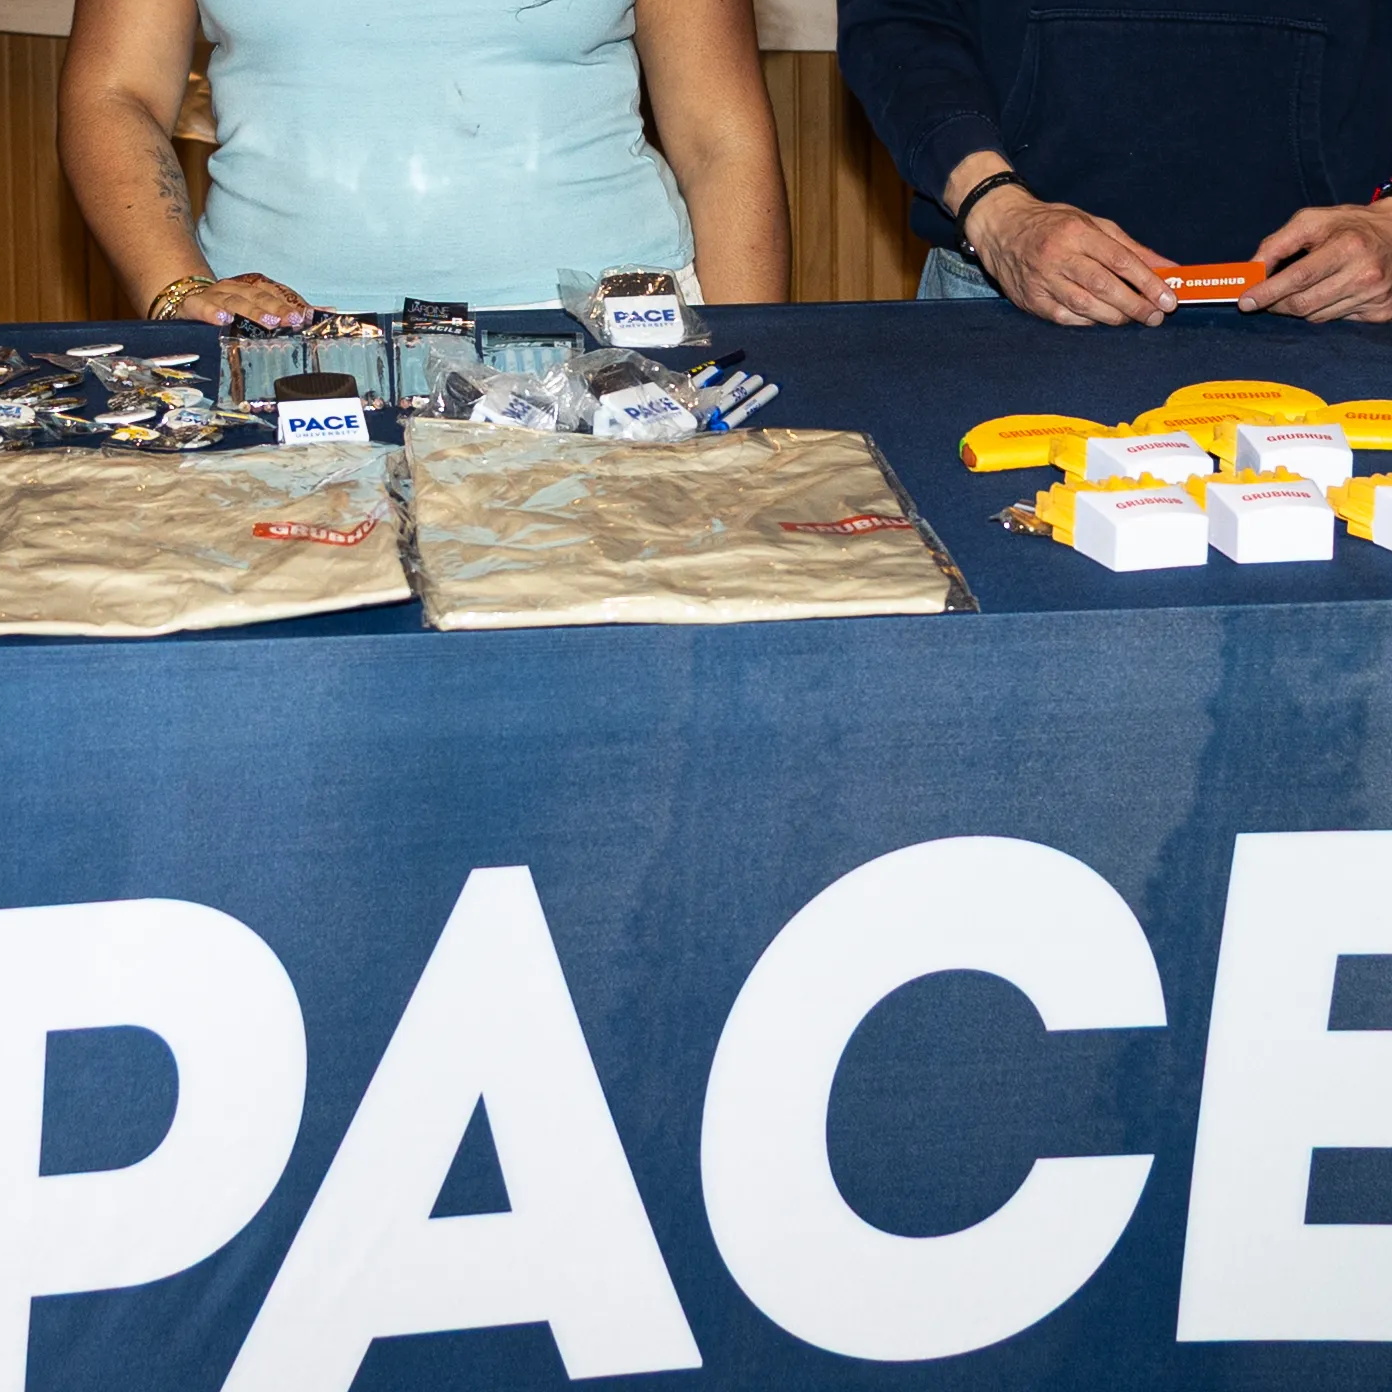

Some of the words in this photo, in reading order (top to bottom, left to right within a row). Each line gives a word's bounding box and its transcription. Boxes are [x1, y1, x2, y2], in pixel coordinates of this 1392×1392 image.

[1185, 277, 1246, 287] GRUBHUB
[613, 308, 677, 324] PACE
[413, 324, 463, 335] PENCILS
[618, 321, 675, 330] UNIVERSITY
[1202, 390, 1282, 401] GRUBHUB
[289, 414, 361, 433] PACE
[295, 428, 359, 439] UNIVERSITY
[1266, 432, 1334, 443] GRUBHUB
[1126, 441, 1190, 454] GRUBHUB
[1242, 490, 1312, 503] GRUBHUB
[1115, 497, 1184, 510] GRUBHUB
[268, 519, 374, 544] GRUBHU
